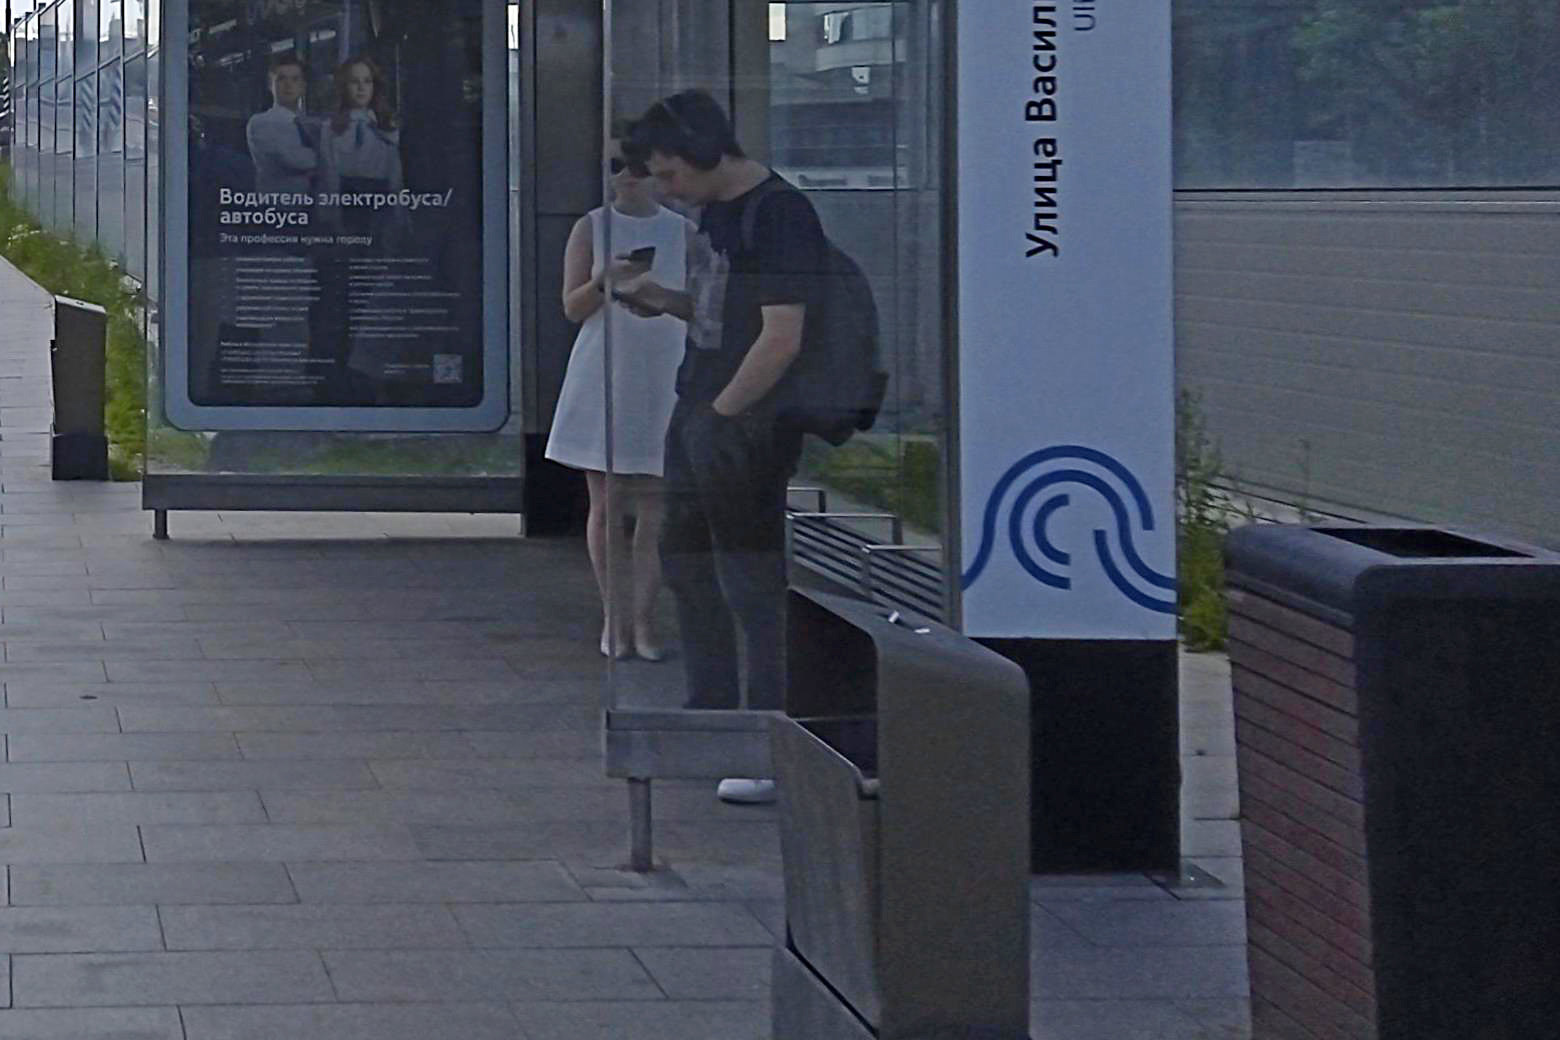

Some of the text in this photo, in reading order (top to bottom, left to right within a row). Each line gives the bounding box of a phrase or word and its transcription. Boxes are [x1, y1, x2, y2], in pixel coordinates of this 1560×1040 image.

[219, 187, 454, 210] Водитель электробуса/
[1025, 137, 1062, 259] Улица
[220, 207, 309, 228] автобуса
[219, 233, 238, 243] Эта
[240, 233, 298, 246] профессия
